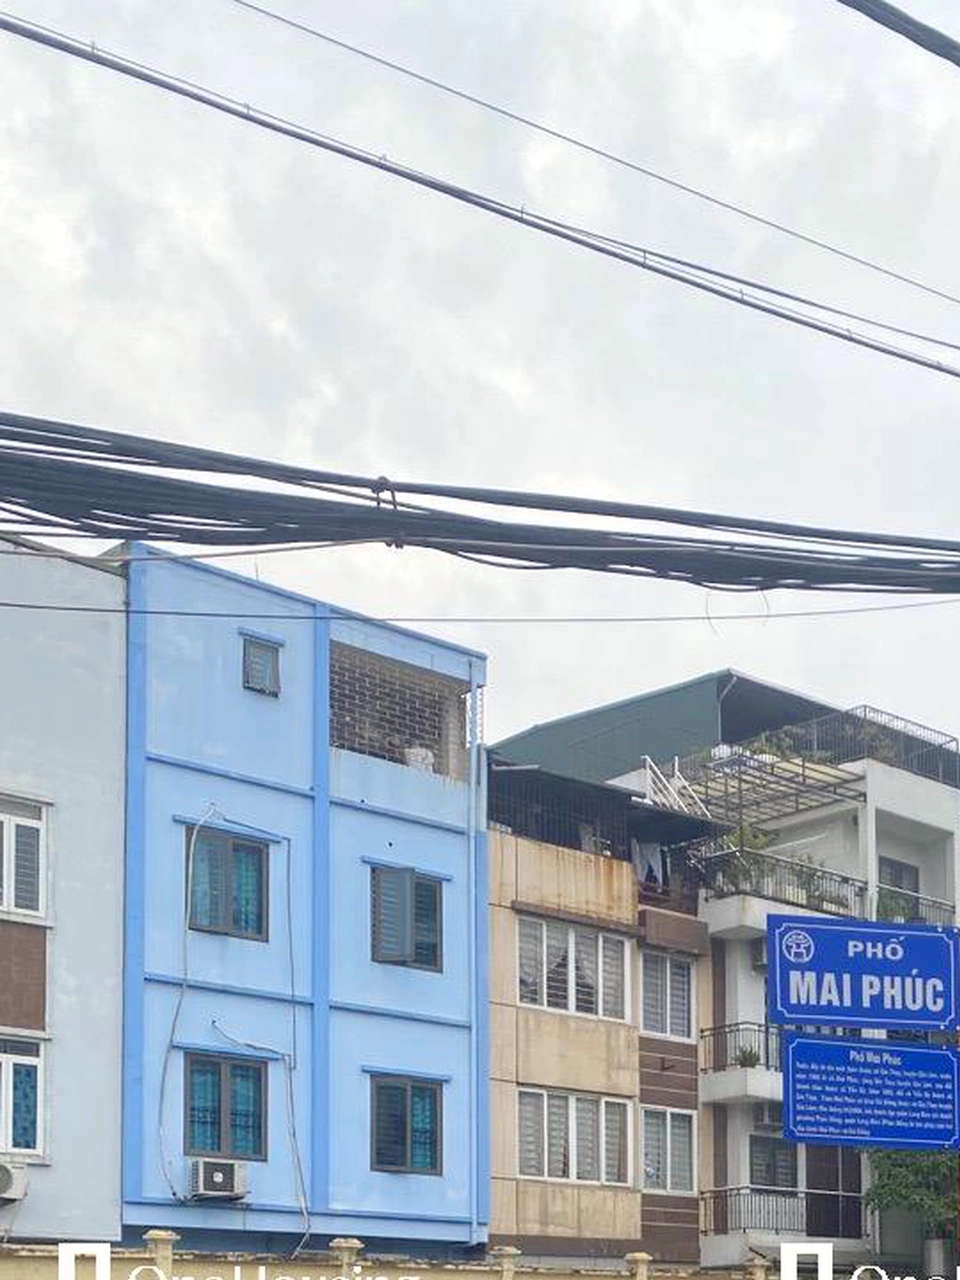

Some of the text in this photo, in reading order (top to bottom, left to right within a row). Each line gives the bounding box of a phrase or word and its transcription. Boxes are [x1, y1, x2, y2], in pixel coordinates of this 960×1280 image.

[848, 937, 904, 960] PHỐ
[789, 969, 944, 1012] MAI PHÚC
